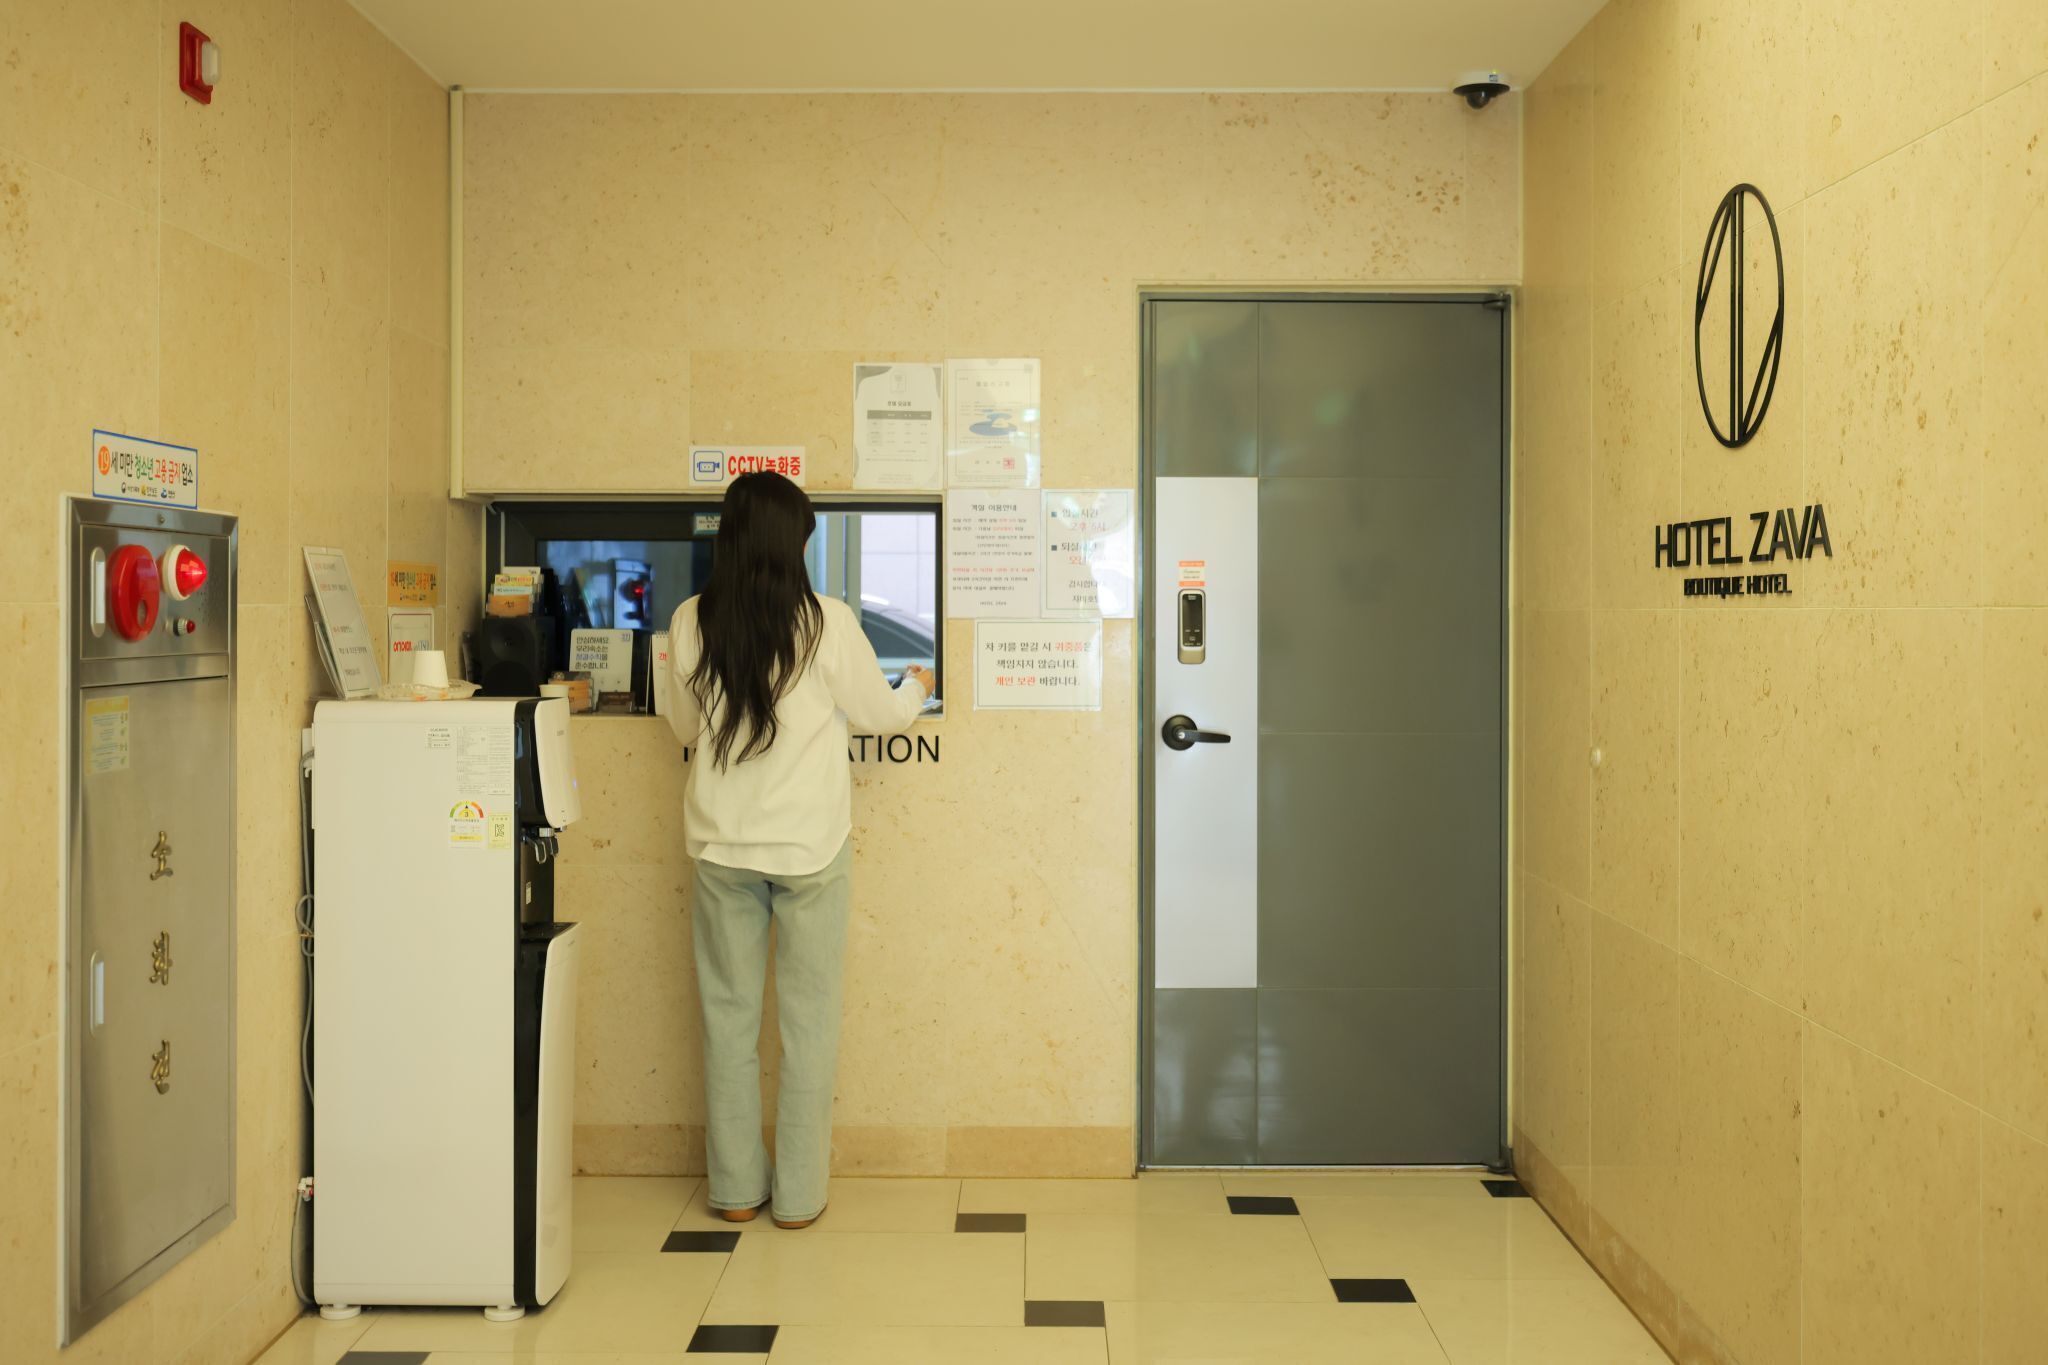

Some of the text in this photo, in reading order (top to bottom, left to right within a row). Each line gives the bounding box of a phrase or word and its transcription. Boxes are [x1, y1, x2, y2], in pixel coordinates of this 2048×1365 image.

[1655, 504, 1832, 568] HOTEL ZAVA
[1068, 580, 1101, 589] 감사합니
[1684, 573, 1792, 599] BOUTIQUE HOTEL
[985, 642, 994, 652] 차
[998, 642, 1016, 652] 키를
[1042, 642, 1051, 652] 시
[997, 659, 1078, 669] 책임지지 않습니다.
[996, 676, 1079, 686] 개인 보관 바랍니다.
